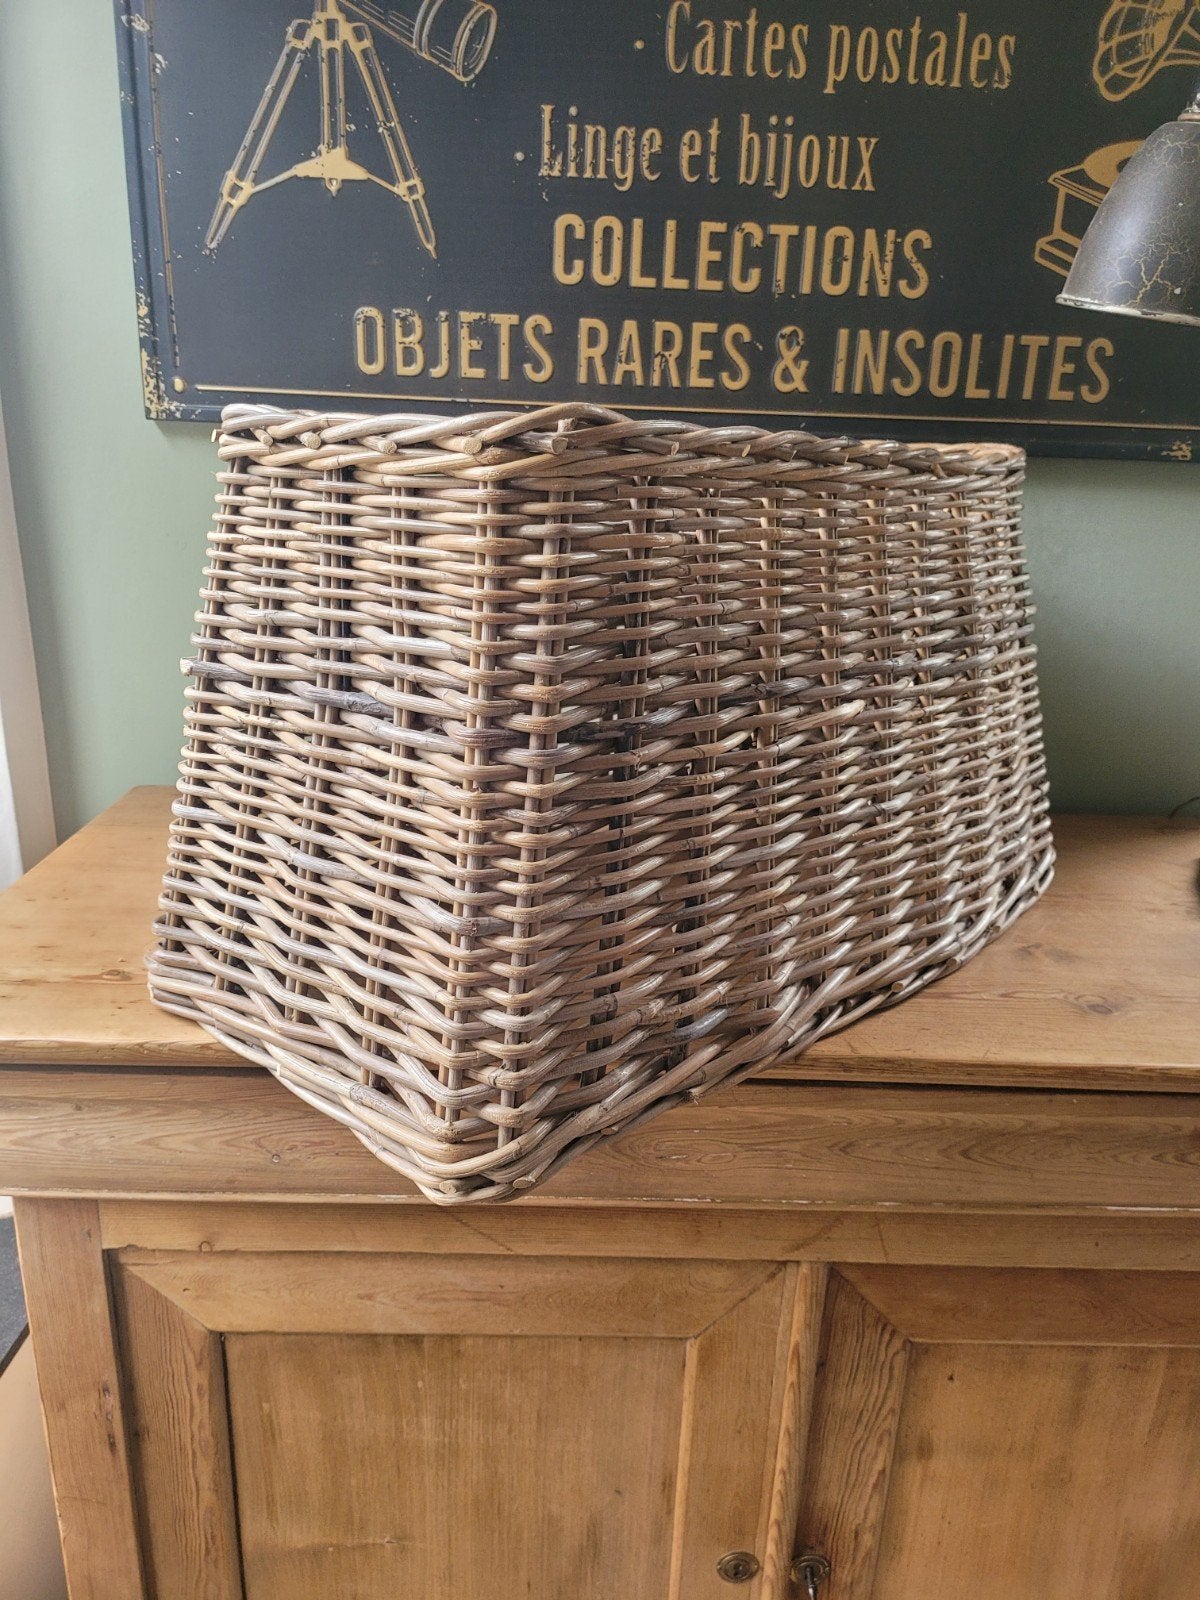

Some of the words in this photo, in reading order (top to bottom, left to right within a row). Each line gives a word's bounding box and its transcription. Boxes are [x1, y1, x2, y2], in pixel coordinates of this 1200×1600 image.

[665, 0, 809, 79] Cartes
[823, 12, 1017, 95] postales
[538, 103, 663, 192] Linge
[679, 115, 722, 185] et
[738, 112, 880, 200] bijoux
[552, 213, 934, 299] COLLECTIONS
[352, 306, 556, 384] OBJETS
[576, 317, 754, 392] RARES
[772, 325, 810, 394] &
[832, 326, 1116, 404] INSOLITES
